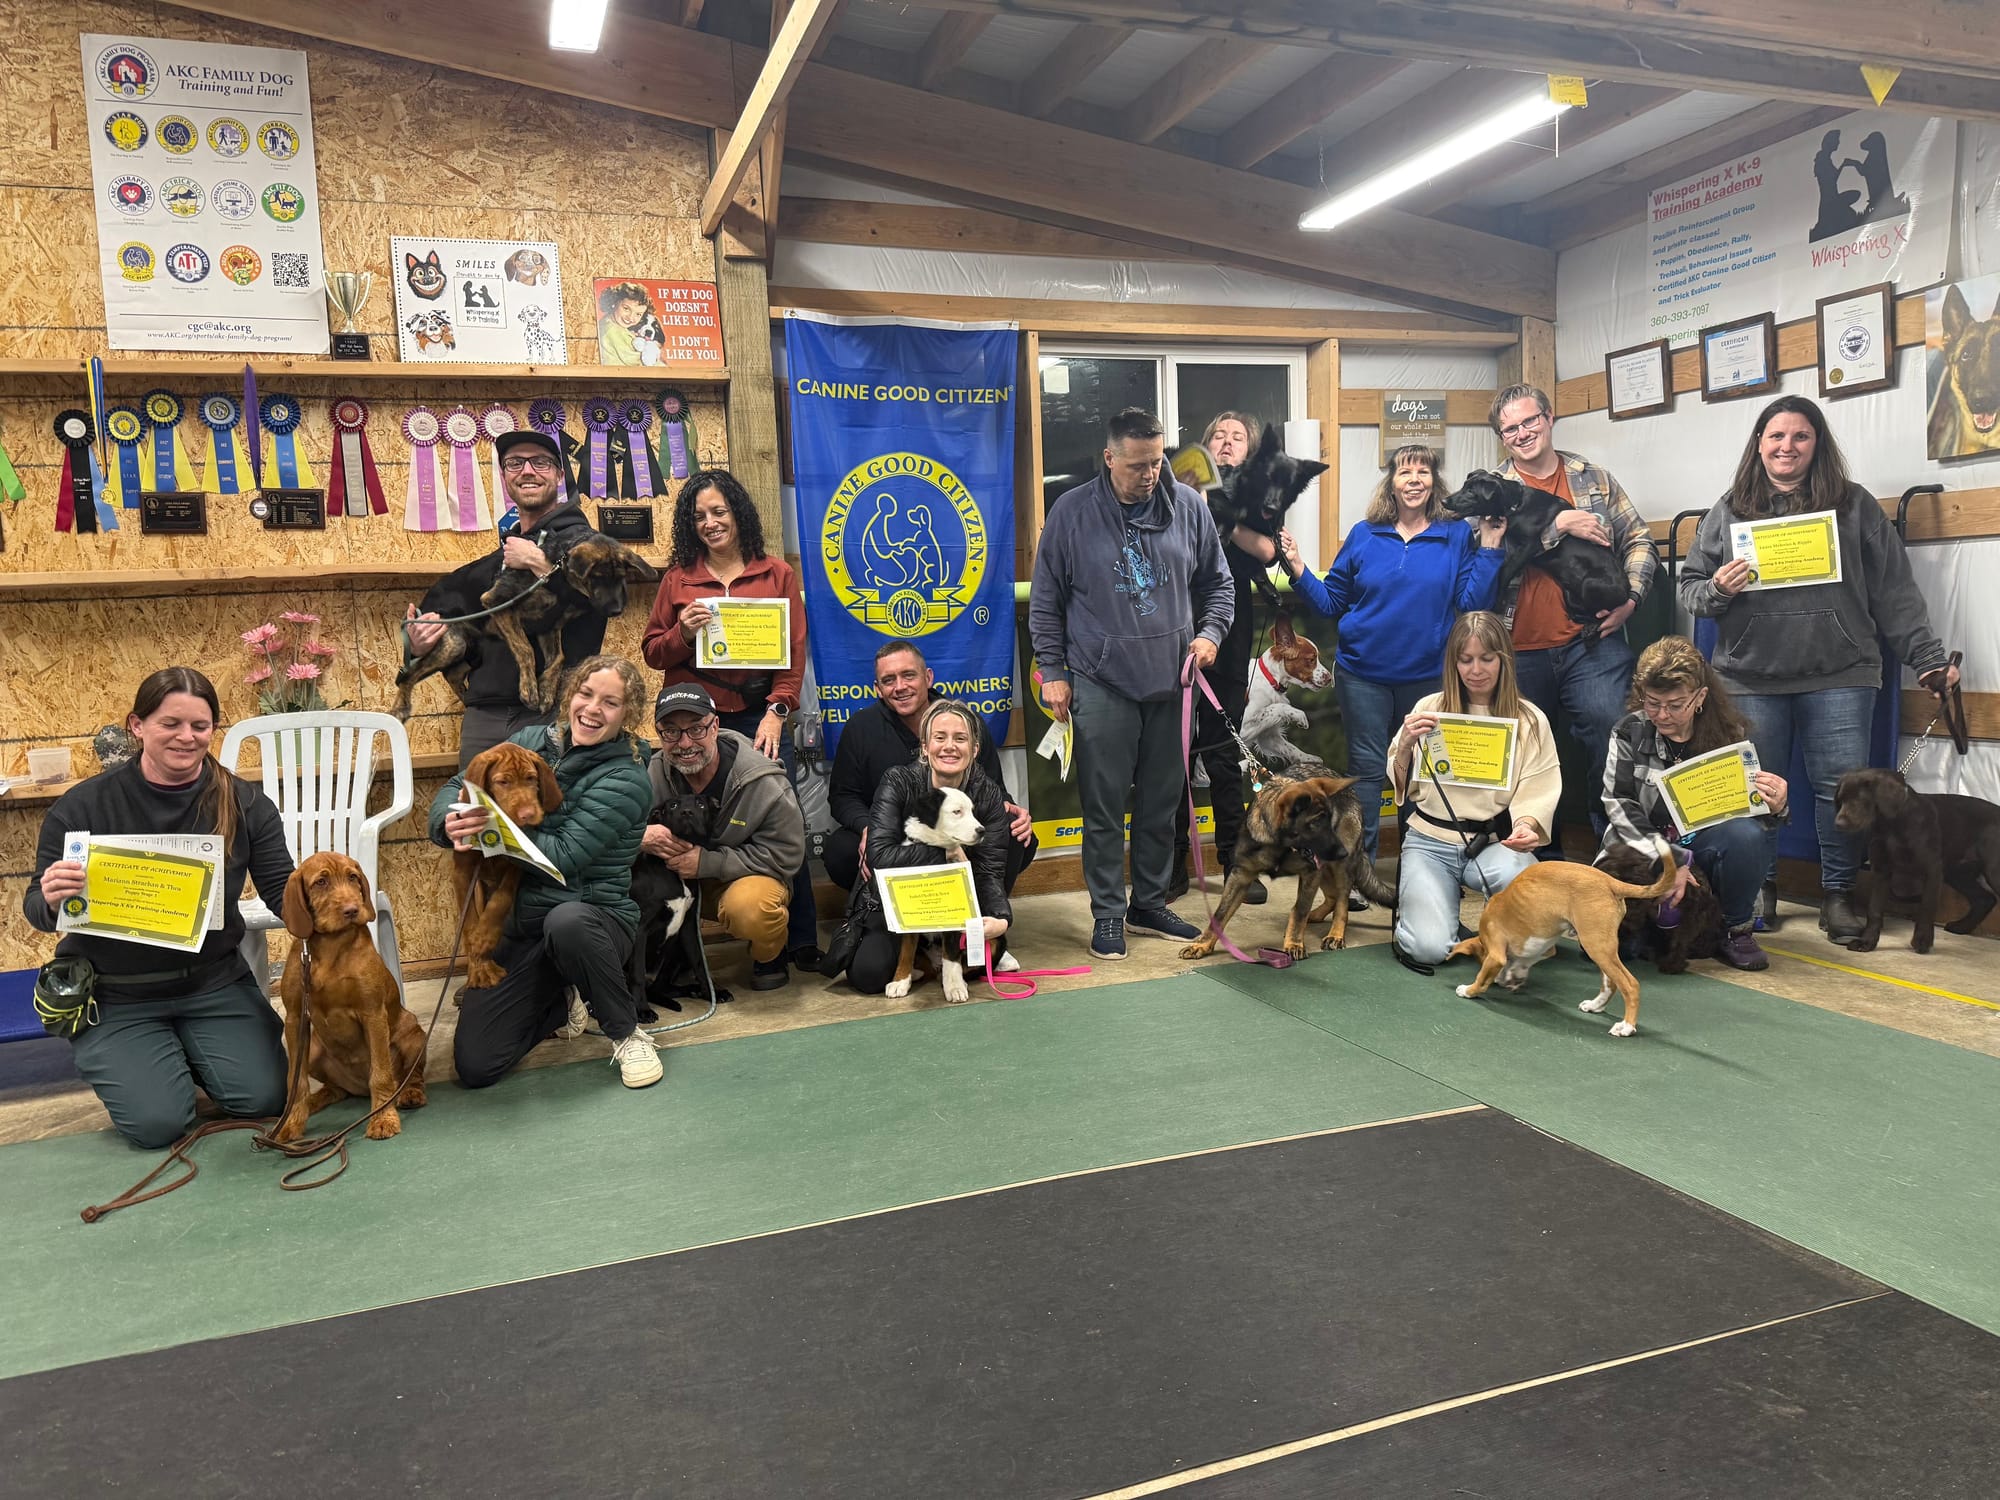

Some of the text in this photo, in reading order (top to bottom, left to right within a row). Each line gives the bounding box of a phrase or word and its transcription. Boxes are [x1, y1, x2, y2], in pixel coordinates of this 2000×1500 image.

[166, 64, 294, 86] AKC FAMILY DOG
[179, 78, 284, 97] Training and Fun!
[1652, 156, 1761, 206] Whispering X K-9
[1652, 174, 1763, 220] Training Academy
[1678, 212, 1731, 233] Reinforcement
[1733, 203, 1755, 217] Group
[1652, 246, 1666, 256] and
[1689, 229, 1720, 243] classes!
[1688, 242, 1730, 256] Obedience,
[1731, 233, 1752, 244] Rally,
[1811, 223, 1907, 268] Whispering X
[456, 259, 496, 269] SMILES
[1688, 253, 1728, 270] Behavioral
[1729, 247, 1753, 259] Issues
[1658, 252, 1776, 292] Certified AKC Canine Good Citizen
[657, 288, 713, 300] IF MY DOG
[1658, 282, 1721, 305] and Trick Evaluator
[665, 302, 709, 313] DOESN'T
[1650, 303, 1710, 327] 360-393-7097
[187, 321, 252, 333] cgc@akc.org
[662, 316, 716, 328] LIKE YOU,
[672, 336, 710, 347] I DON'T
[1720, 336, 1749, 347] CERTIFICATE
[666, 350, 720, 360] LIKE YOU.
[796, 378, 1010, 404] CANINE GOOD CITIZEN
[1392, 394, 1427, 422] dogs
[822, 456, 984, 563] CANINE GOOD CITIZEN
[895, 598, 920, 627] AKC
[99, 861, 139, 870] CERTIFICATE
[150, 867, 192, 878] ACHIEVEMENT
